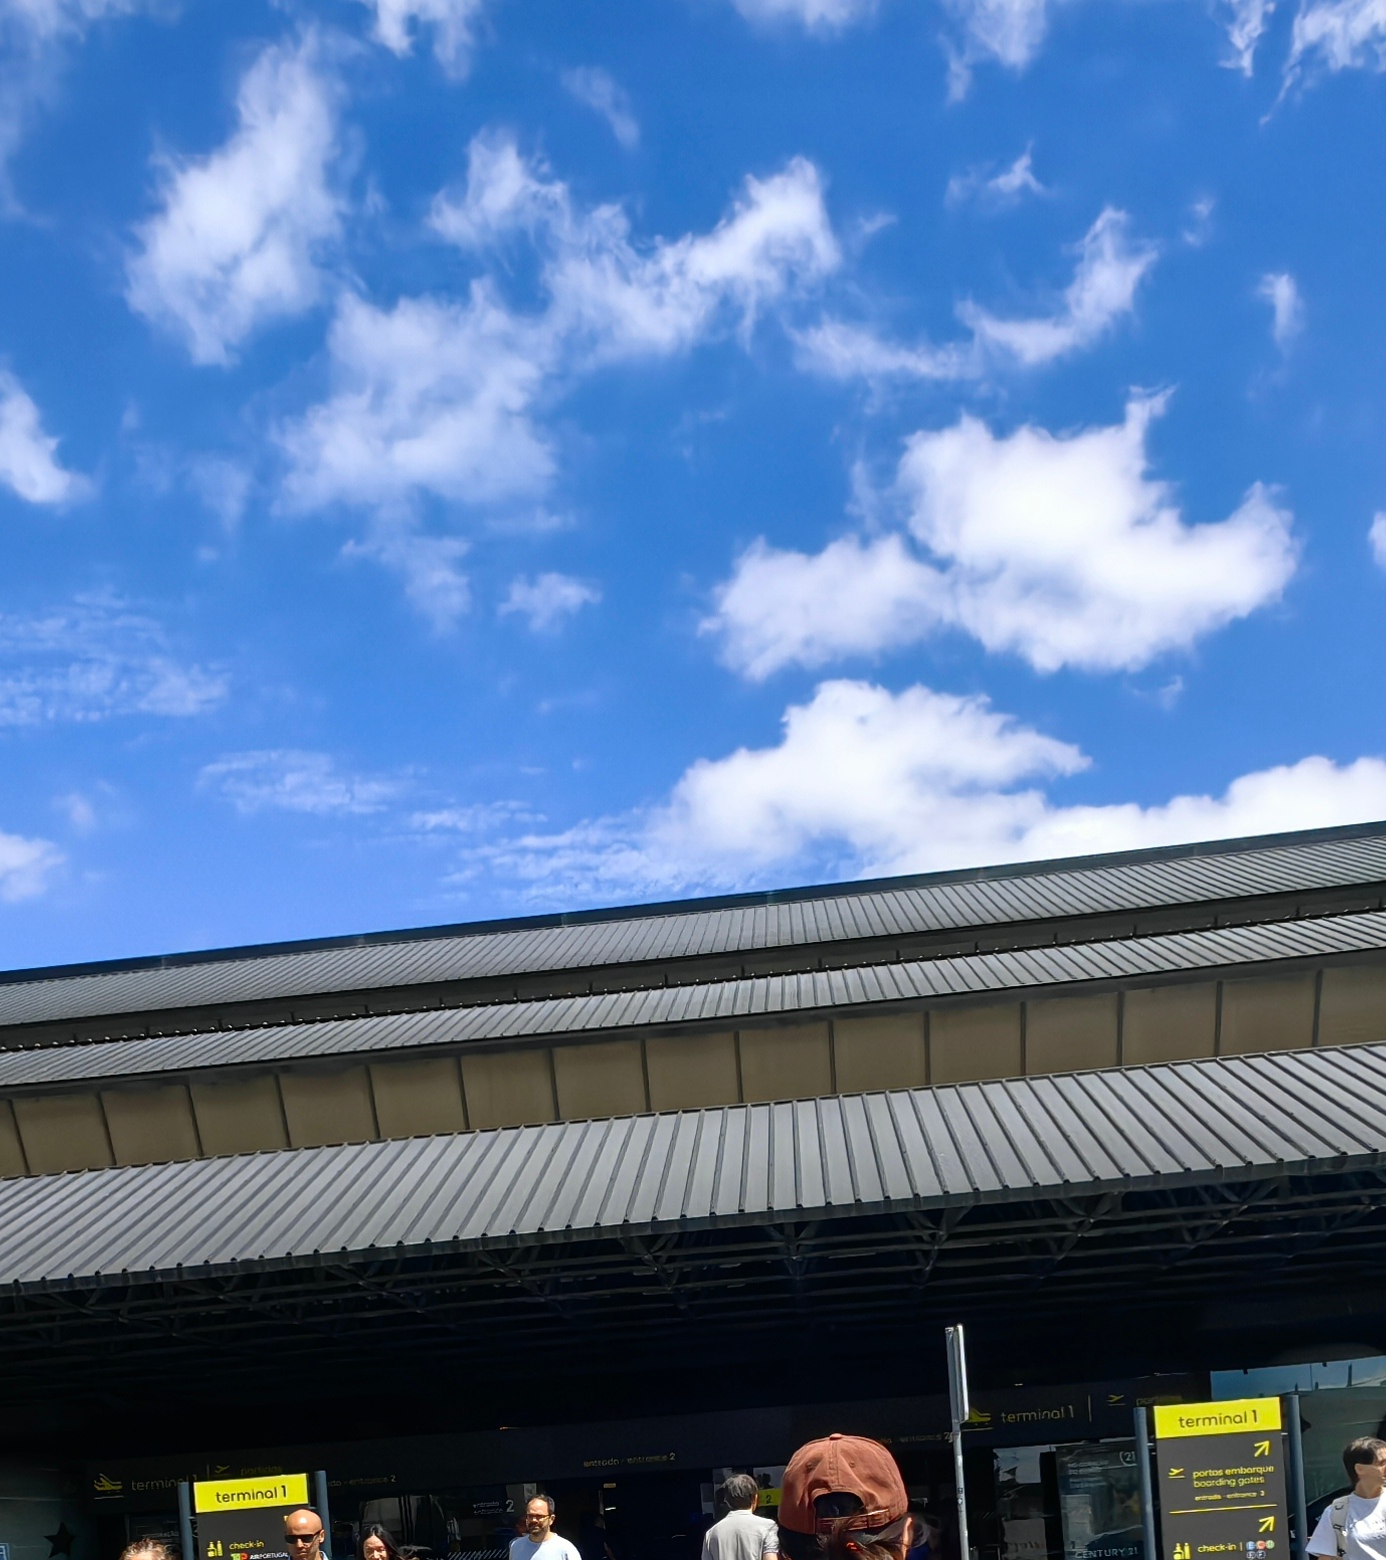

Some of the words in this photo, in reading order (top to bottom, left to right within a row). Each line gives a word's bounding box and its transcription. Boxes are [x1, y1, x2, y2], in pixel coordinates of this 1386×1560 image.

[1001, 1407, 1064, 1424] terminal
[1067, 1405, 1074, 1418] 1
[1178, 1410, 1247, 1428] terminal
[1251, 1409, 1257, 1423] 1
[669, 1452, 675, 1461] 2
[216, 1486, 277, 1503] terminal
[281, 1485, 287, 1498] 1
[506, 1499, 514, 1513] 2
[1075, 1549, 1124, 1559] CENTURY
[1197, 1542, 1236, 1553] check-in
